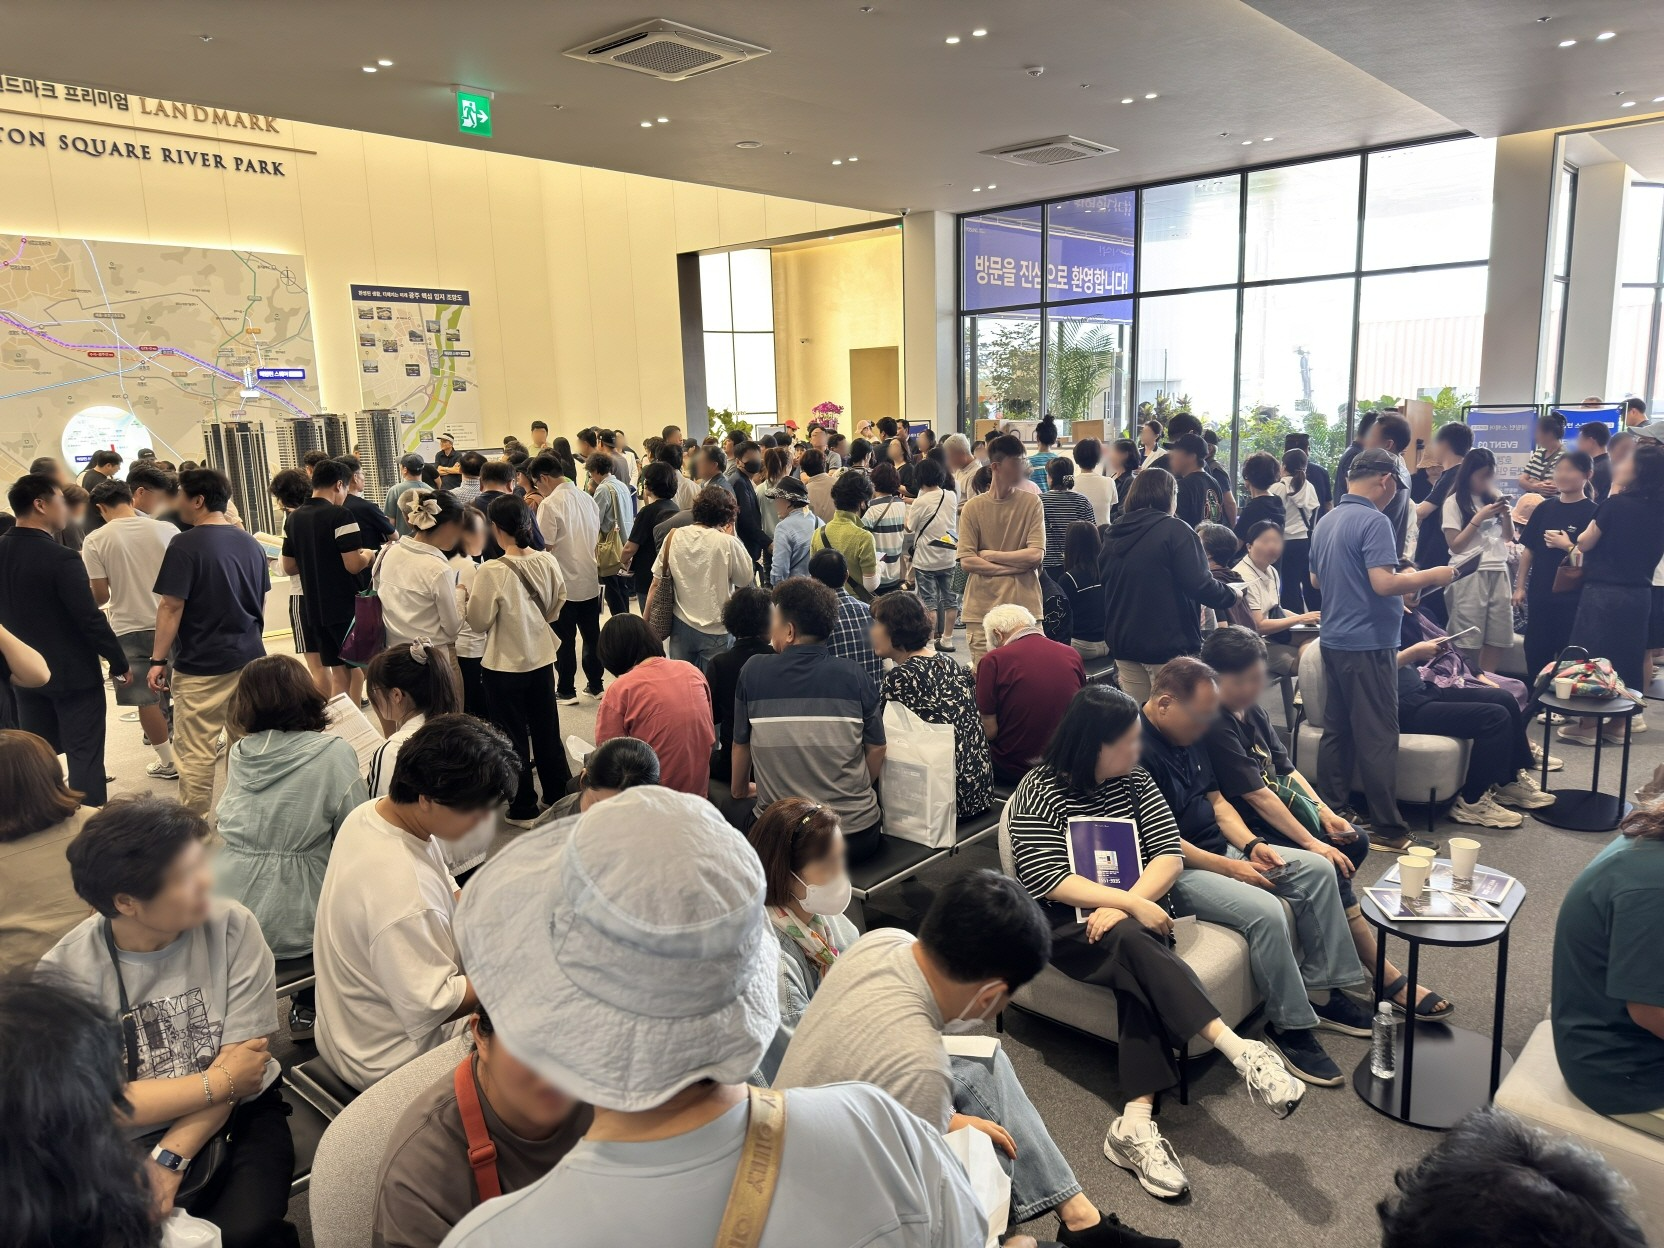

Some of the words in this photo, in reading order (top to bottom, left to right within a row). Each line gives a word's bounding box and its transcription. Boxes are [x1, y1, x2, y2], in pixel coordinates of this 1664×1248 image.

[64, 85, 129, 111] 프리미엄
[138, 96, 280, 133] LANDMARK
[59, 134, 151, 160] SQUARE
[160, 147, 227, 169] RIVER
[233, 156, 286, 176] PARK
[975, 255, 1016, 286] 방문을
[1019, 260, 1069, 290] 진심으로
[1071, 265, 1129, 295] 환영합니다!
[421, 292, 433, 300] 핵심
